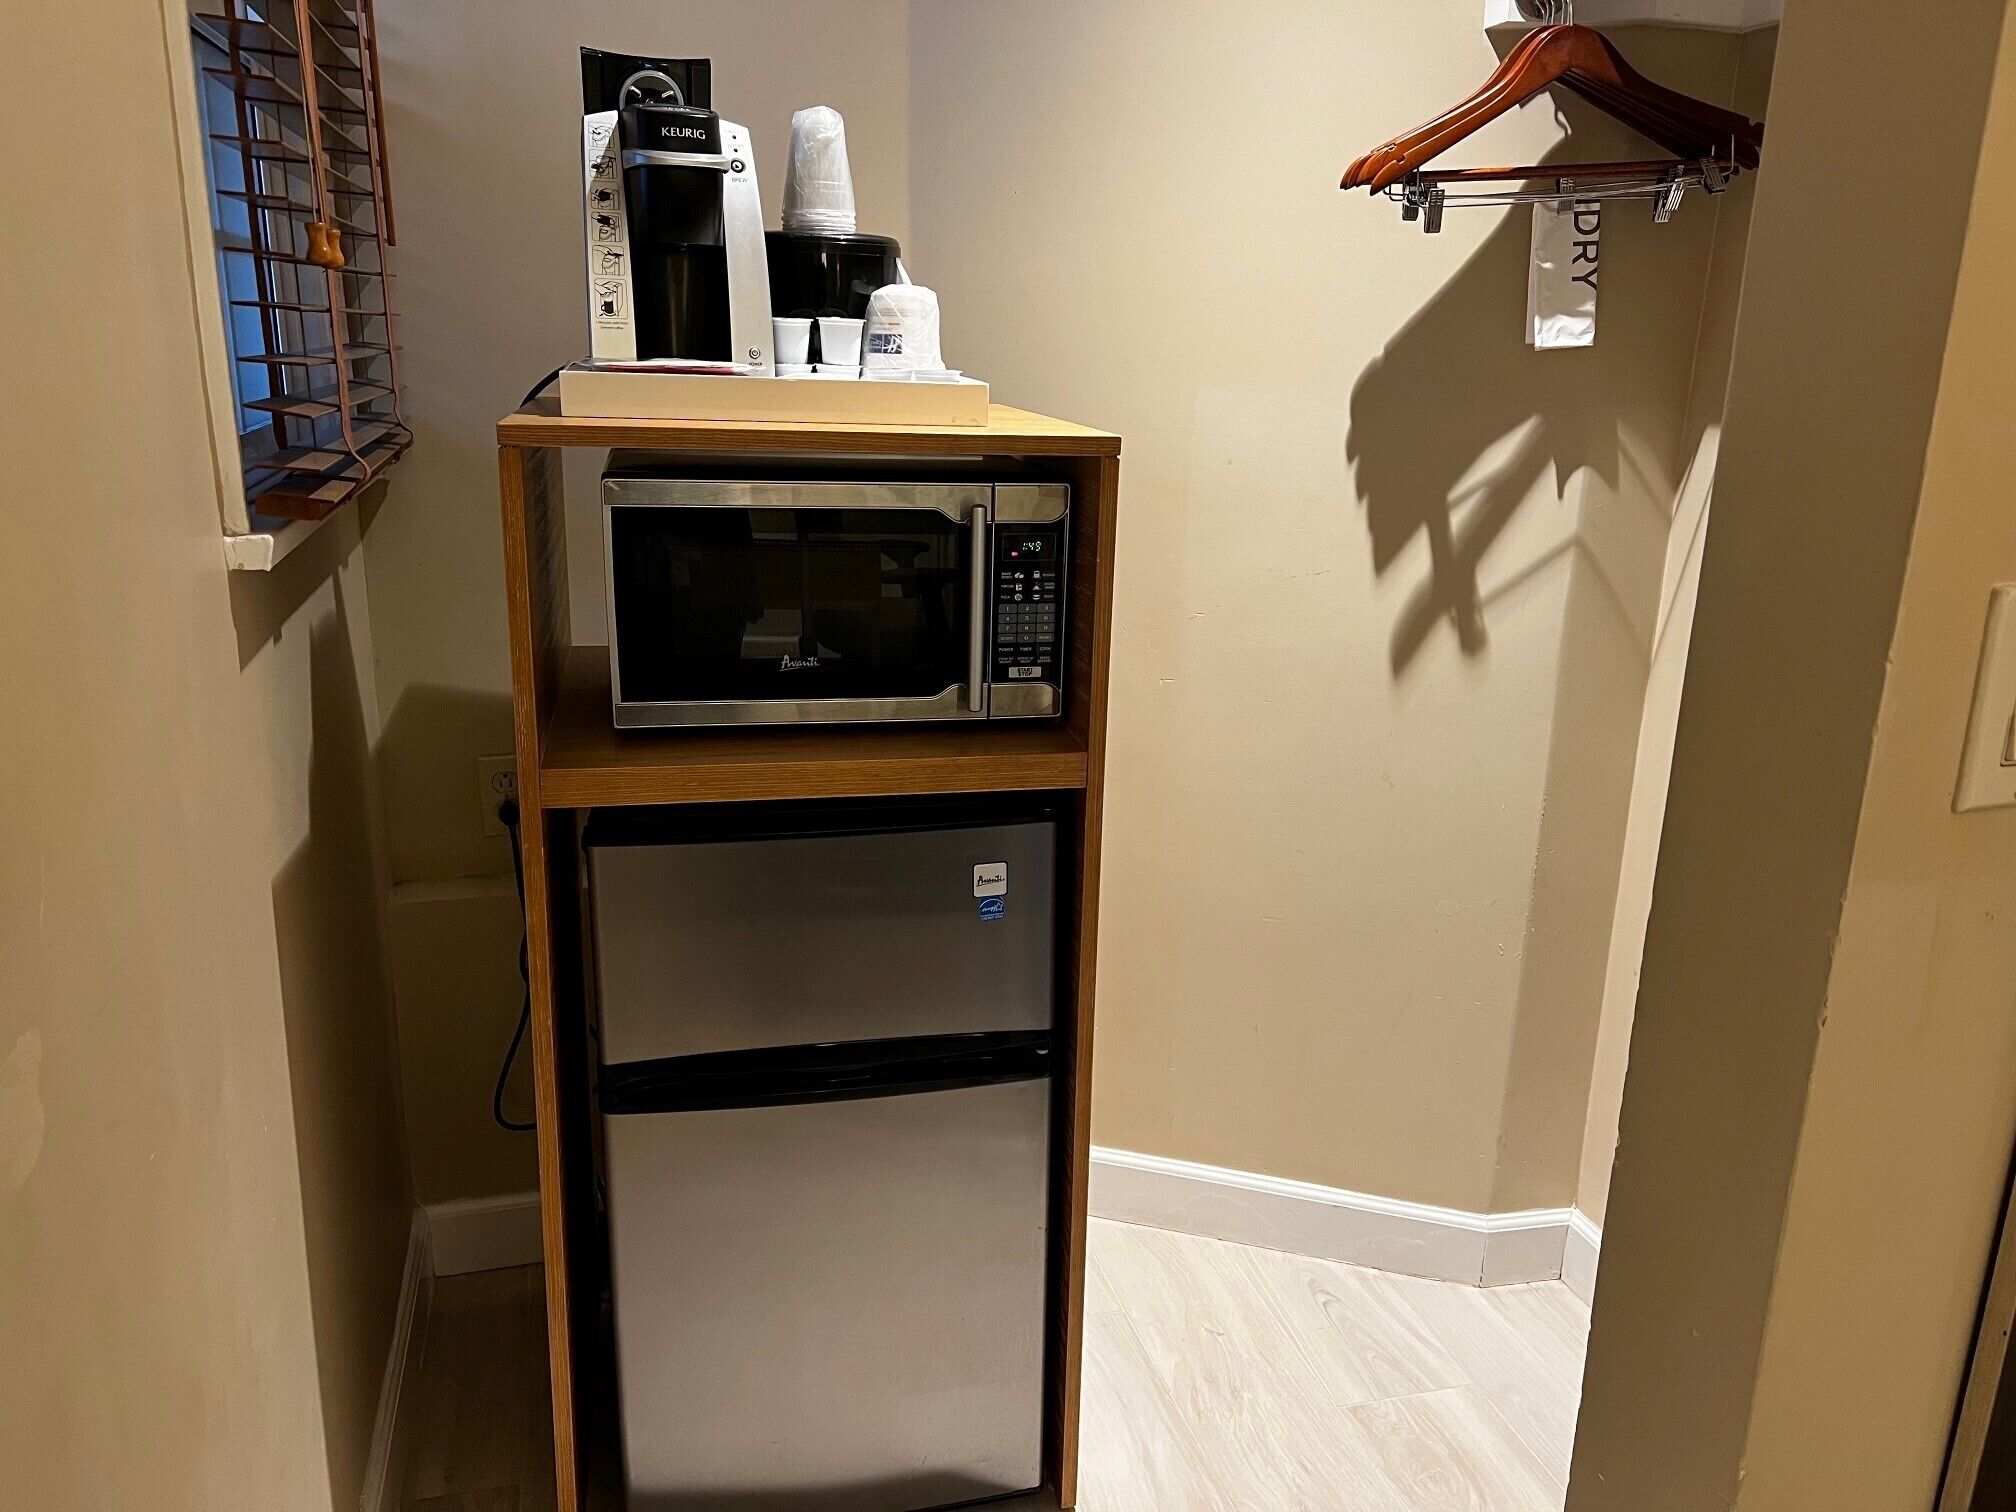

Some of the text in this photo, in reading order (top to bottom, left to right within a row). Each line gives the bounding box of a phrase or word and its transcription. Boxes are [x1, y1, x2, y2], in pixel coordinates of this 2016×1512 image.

[661, 126, 706, 140] KEURIG
[779, 654, 820, 671] Avanti
[976, 874, 1005, 887] Avanti
